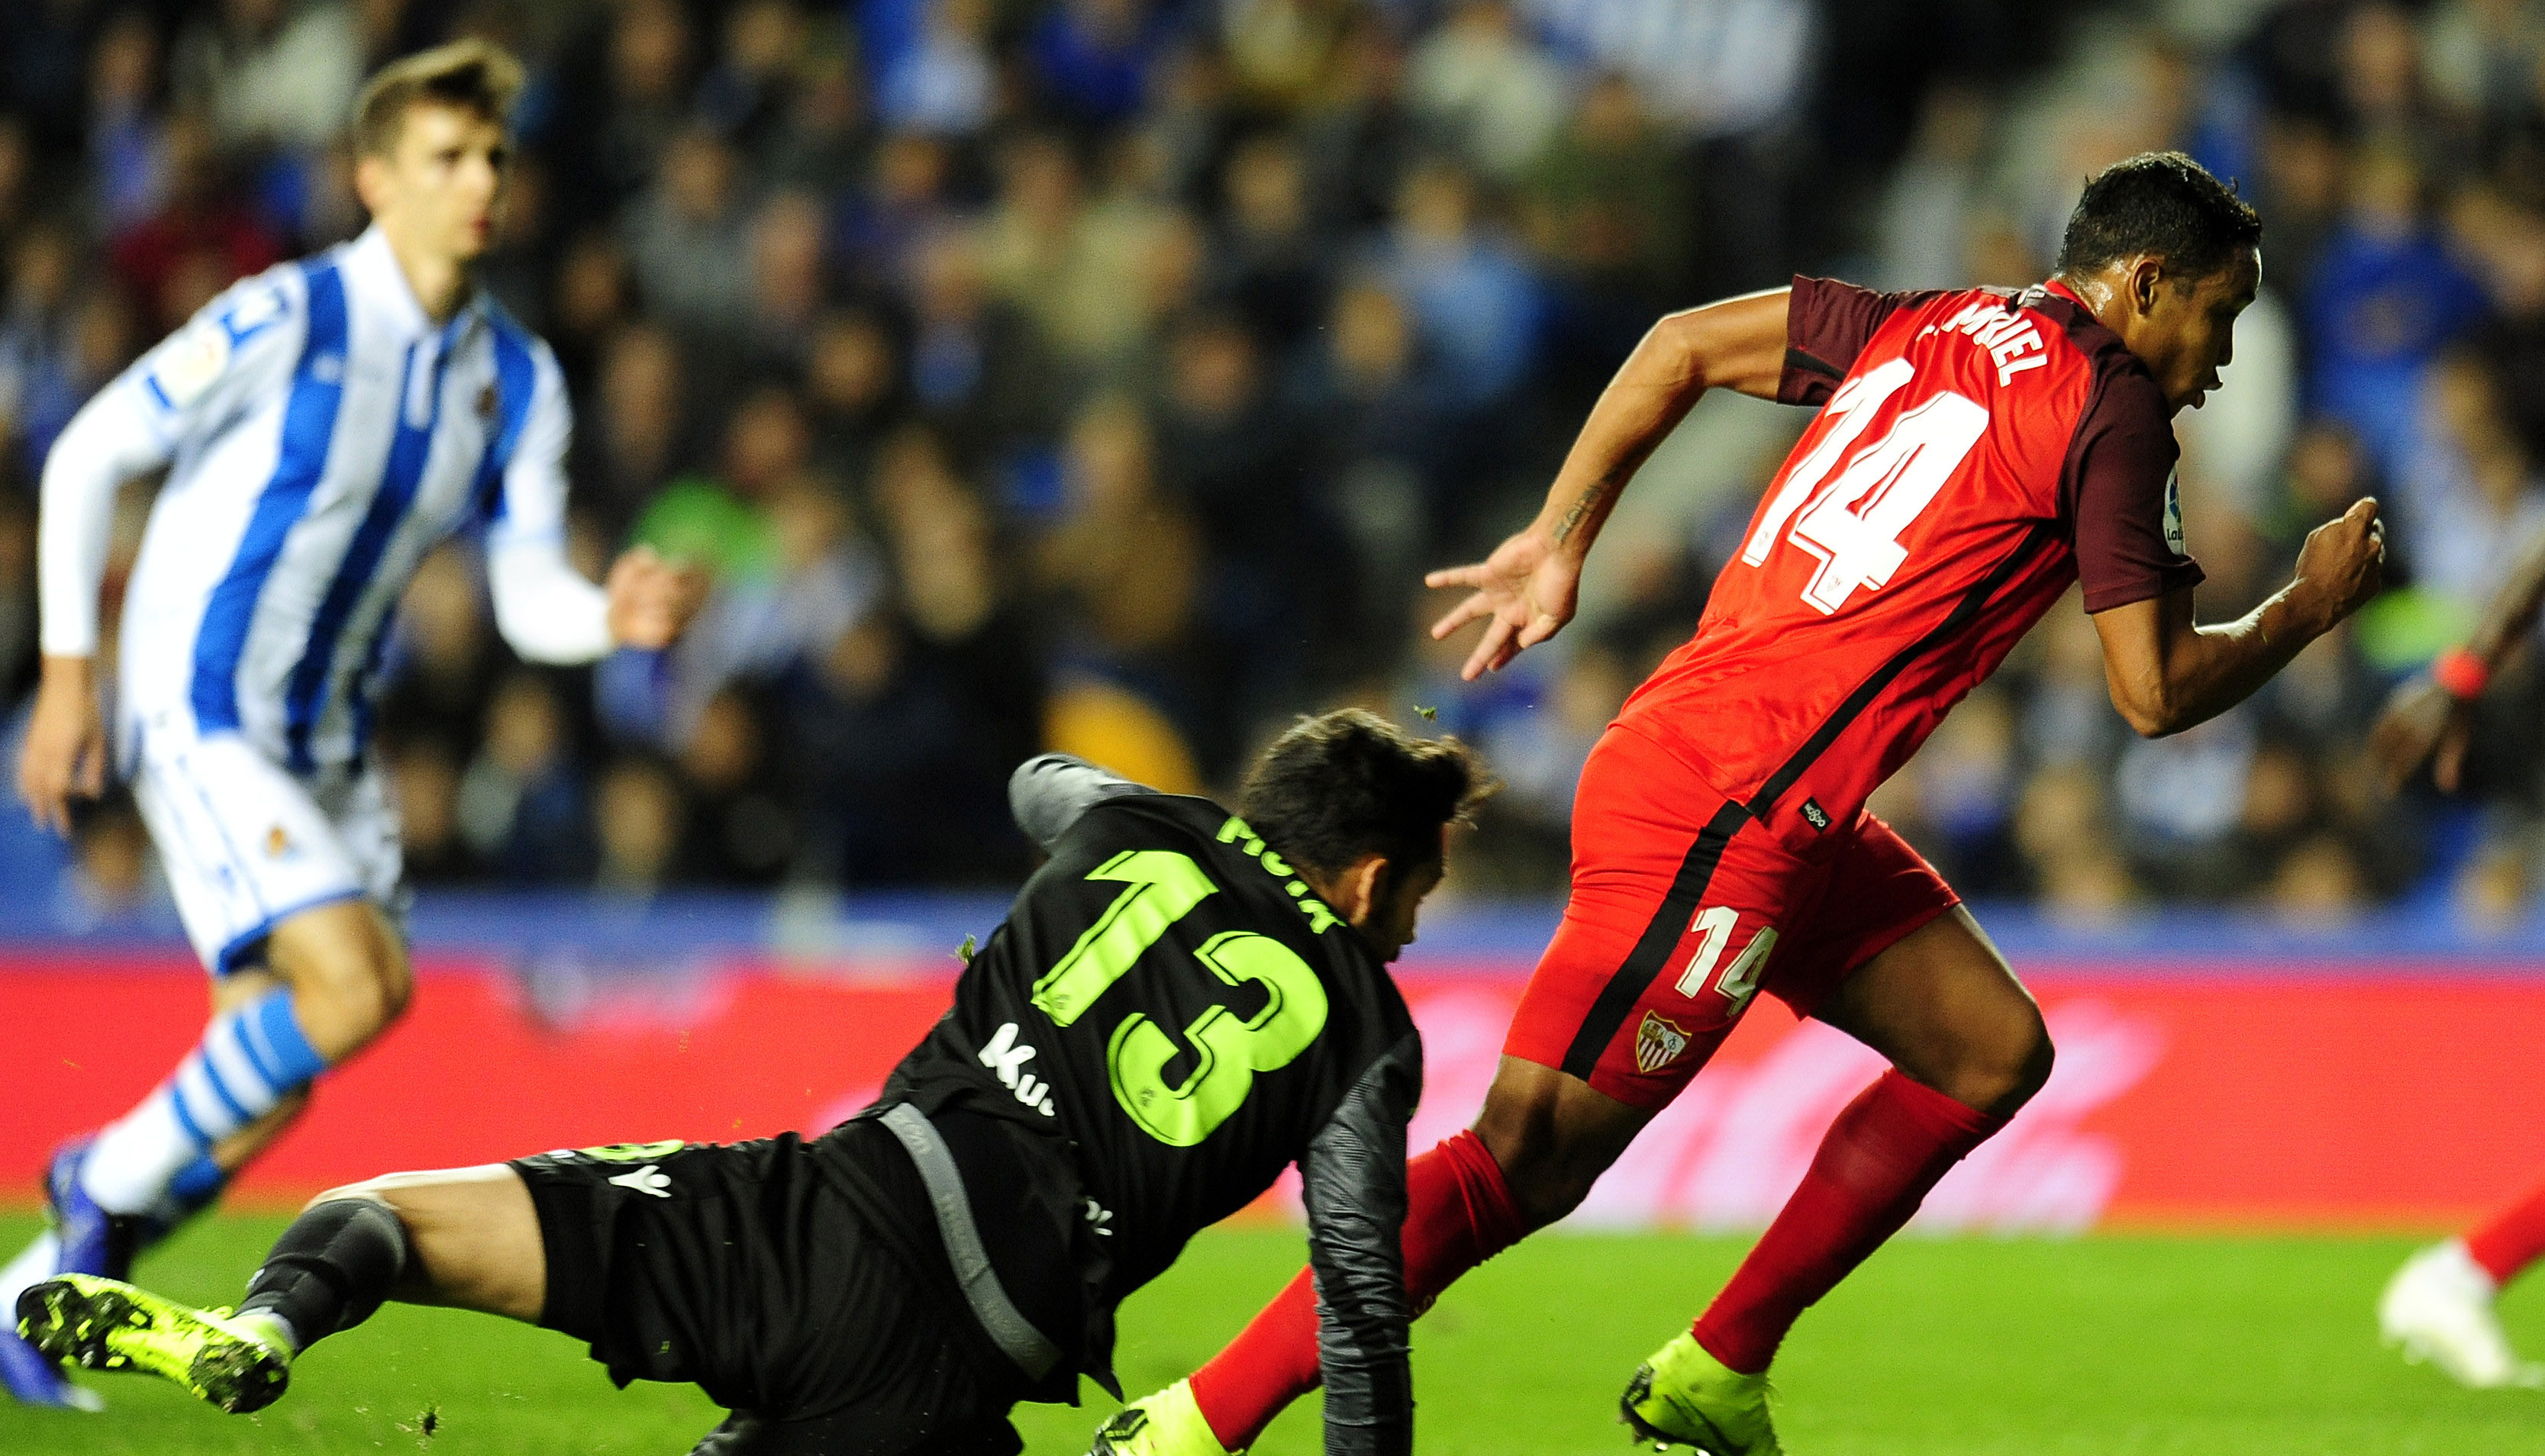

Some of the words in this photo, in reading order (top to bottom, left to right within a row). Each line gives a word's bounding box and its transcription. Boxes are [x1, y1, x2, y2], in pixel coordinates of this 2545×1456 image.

[1742, 357, 1989, 617] 14
[2166, 528, 2184, 541] LaL
[1031, 849, 1329, 1147] 13
[1674, 905, 1779, 1018] 14
